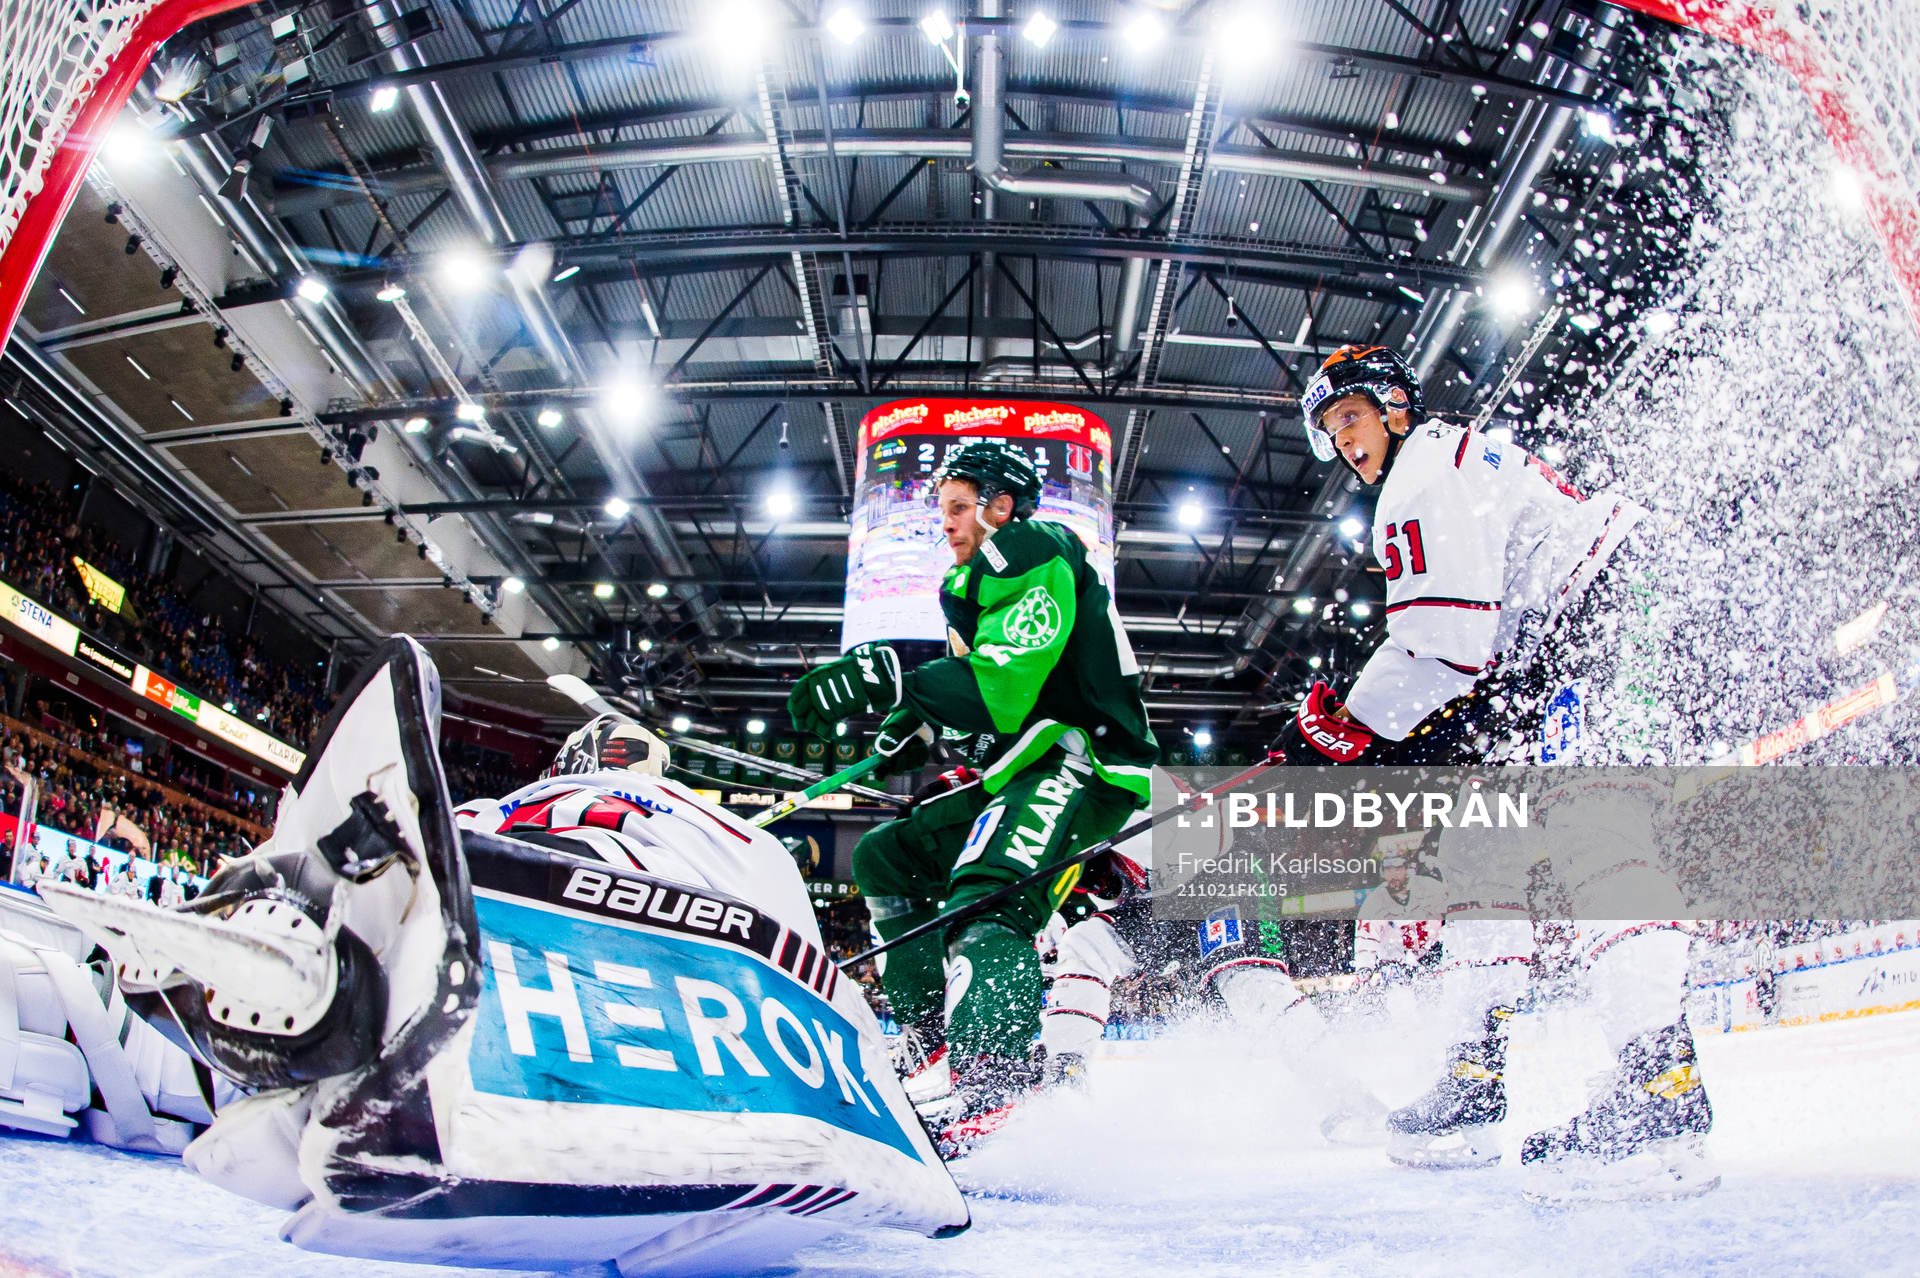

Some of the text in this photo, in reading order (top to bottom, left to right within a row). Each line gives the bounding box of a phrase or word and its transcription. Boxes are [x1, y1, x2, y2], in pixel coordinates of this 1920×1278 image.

[918, 443, 935, 461] 2
[1034, 447, 1050, 466] 1
[1385, 518, 1428, 582] 51
[20, 598, 54, 629] STENA
[487, 940, 880, 1117] HEROK
